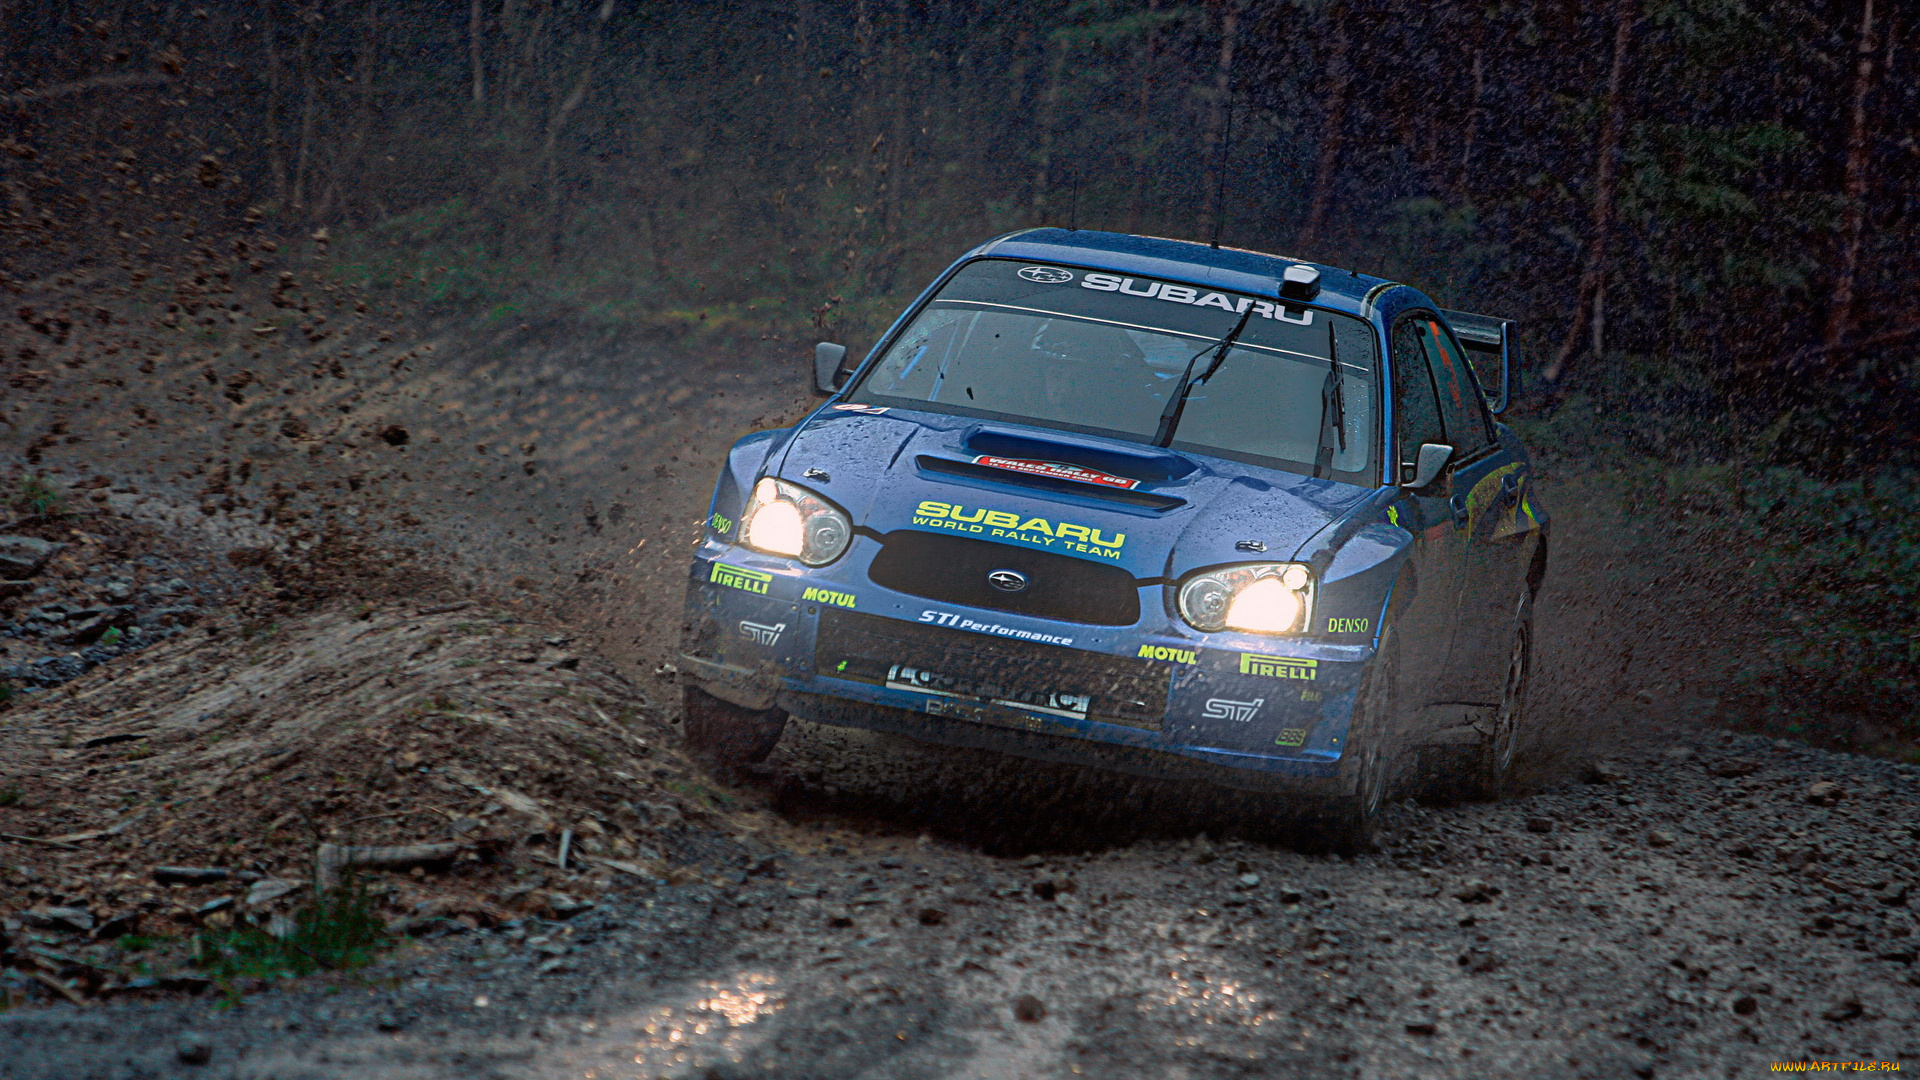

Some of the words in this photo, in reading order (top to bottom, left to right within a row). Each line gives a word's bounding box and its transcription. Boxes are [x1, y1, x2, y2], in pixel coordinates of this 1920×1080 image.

[1081, 273, 1313, 326] SUBARU
[989, 458, 1047, 470] WALES
[1049, 467, 1100, 479] RALLY
[711, 512, 732, 534] DENSO
[916, 500, 1126, 548] SUBARU
[912, 516, 983, 533] WORLD
[991, 528, 1056, 546] RALLY
[1064, 540, 1121, 560] TEAM
[710, 562, 773, 594] PIRELLI
[802, 587, 857, 608] MOTUL
[918, 610, 960, 627] STI
[960, 619, 1073, 646] Performance
[1328, 618, 1369, 633] DENSO
[1137, 644, 1197, 665] MOTUL
[1239, 652, 1318, 680] PIRELLI
